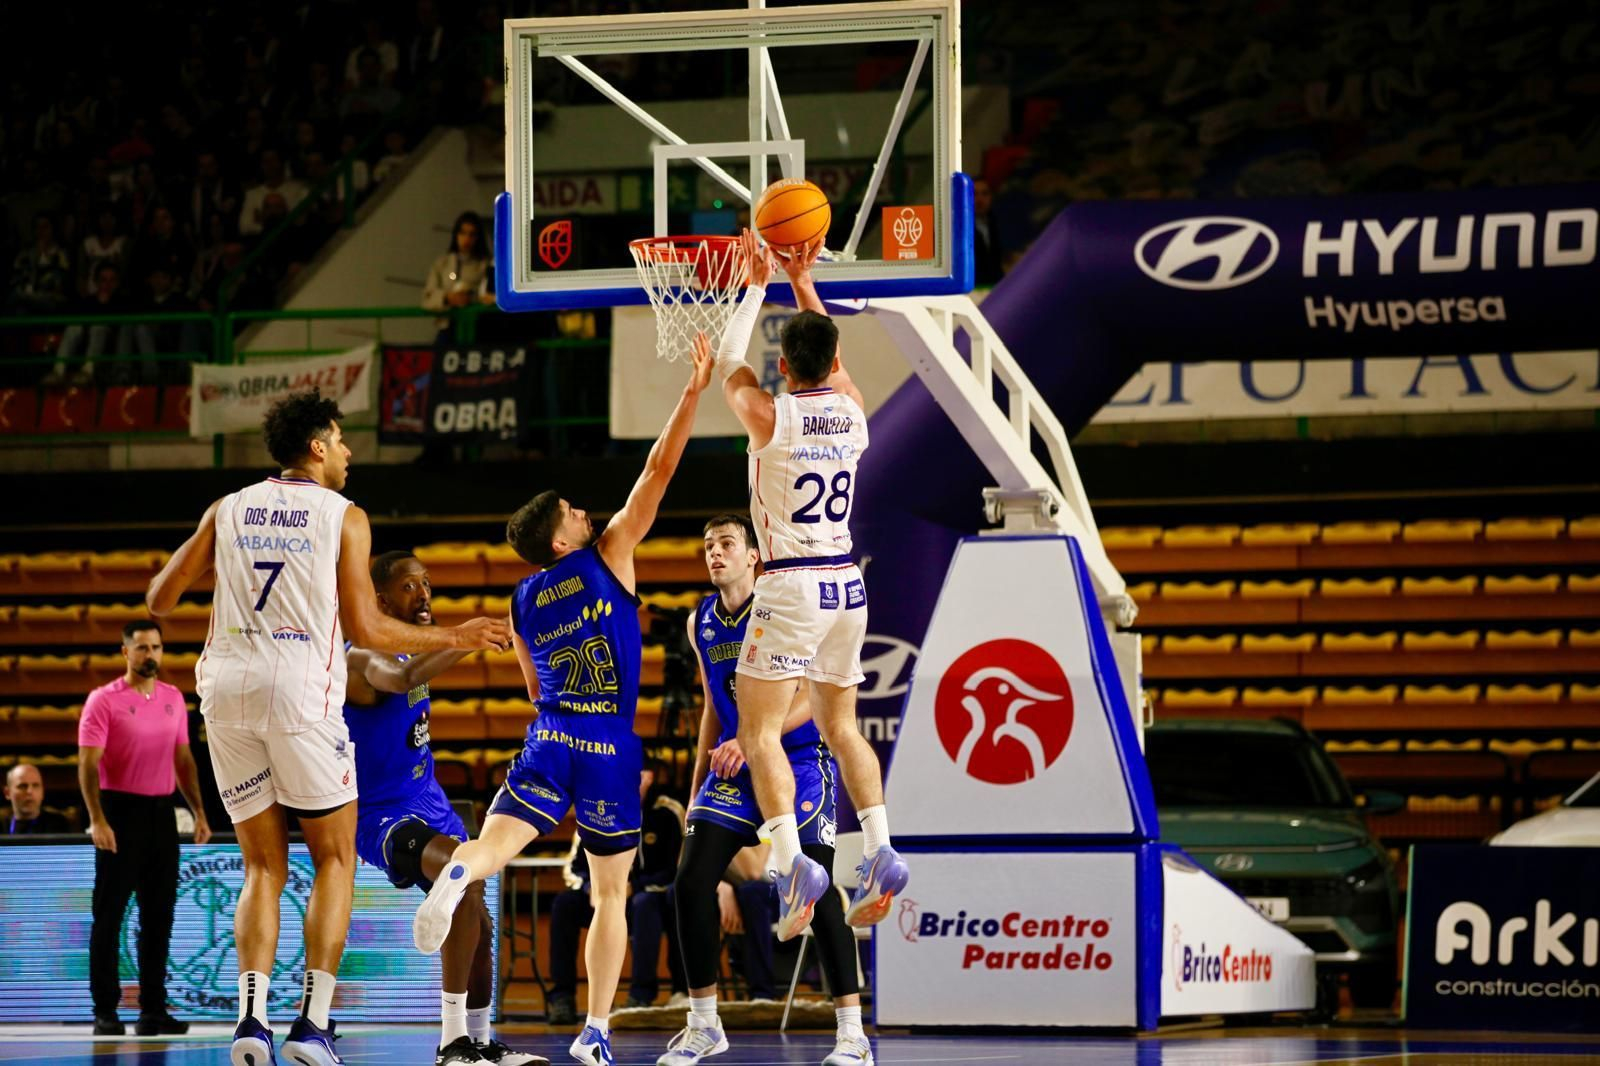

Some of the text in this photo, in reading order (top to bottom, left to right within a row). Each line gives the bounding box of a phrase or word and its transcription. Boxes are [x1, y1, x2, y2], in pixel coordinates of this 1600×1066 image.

[1302, 208, 1599, 277] HYUND
[1305, 296, 1506, 332] Hyupersa
[434, 397, 517, 433] OBRA
[791, 470, 851, 524] 28
[244, 507, 309, 528] DOS ANJOS
[233, 535, 313, 553] ABANCA
[253, 561, 286, 612] 7
[554, 575, 584, 599] LISBOA
[534, 615, 583, 647] cloud.gal
[547, 634, 619, 696] 28
[918, 910, 1110, 938] BricoCentro
[962, 943, 1113, 970] Paradelo
[1183, 942, 1272, 983] BricoCentro
